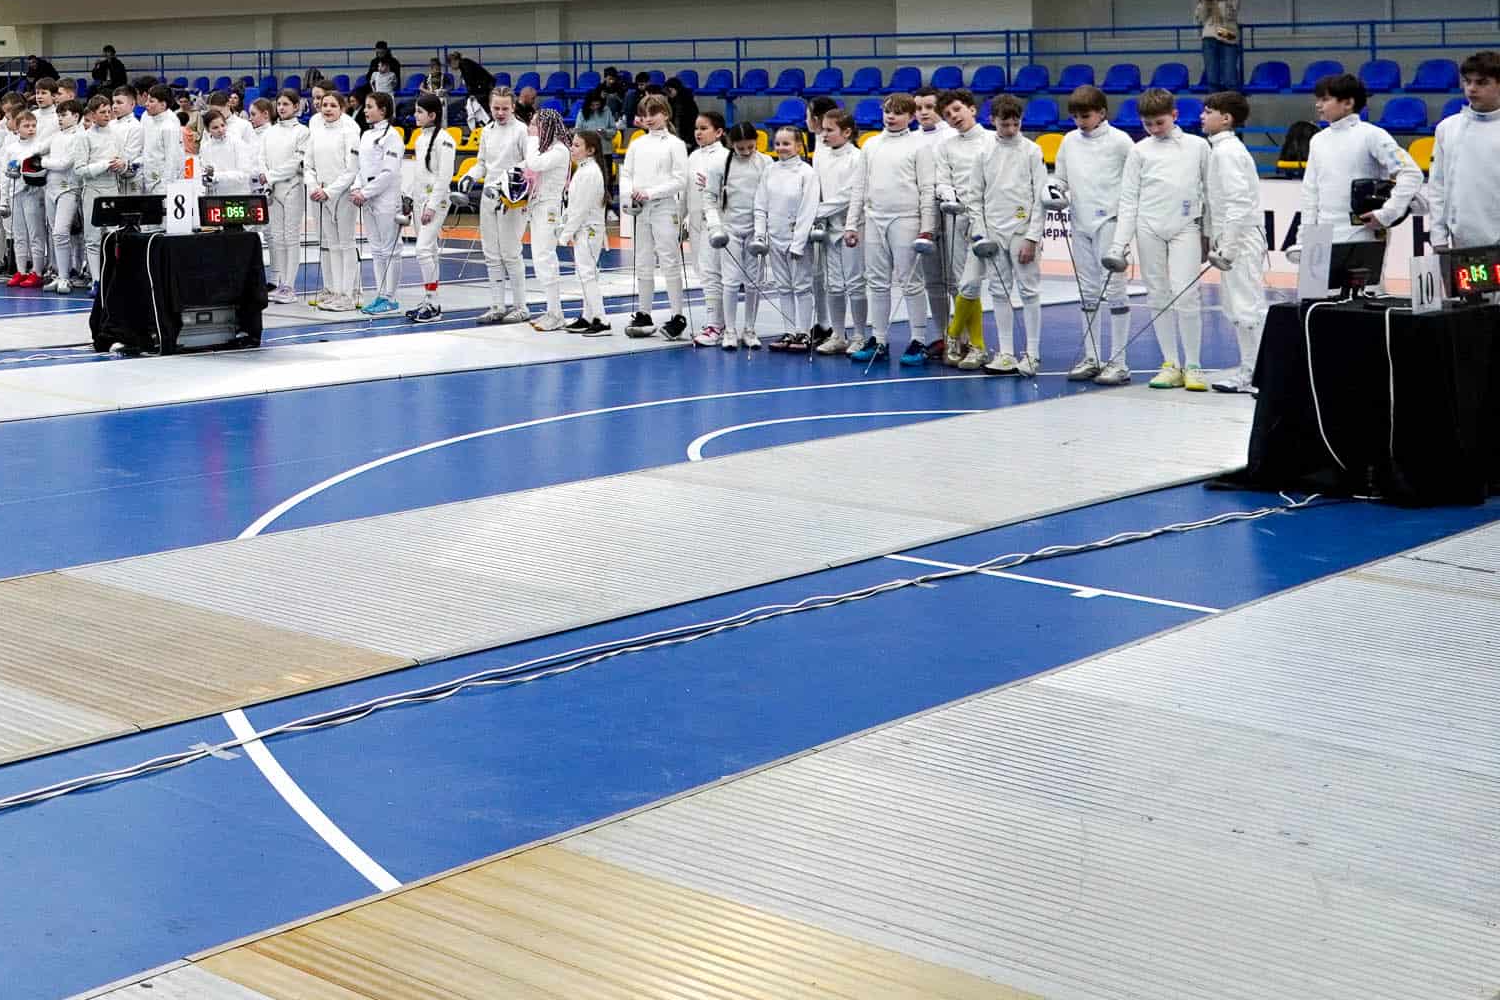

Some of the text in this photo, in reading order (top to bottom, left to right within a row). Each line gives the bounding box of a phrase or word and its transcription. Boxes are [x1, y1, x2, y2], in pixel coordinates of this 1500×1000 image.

[174, 194, 185, 219] 8
[210, 207, 221, 222] 12
[256, 207, 264, 221] 3
[1418, 271, 1434, 305] 10
